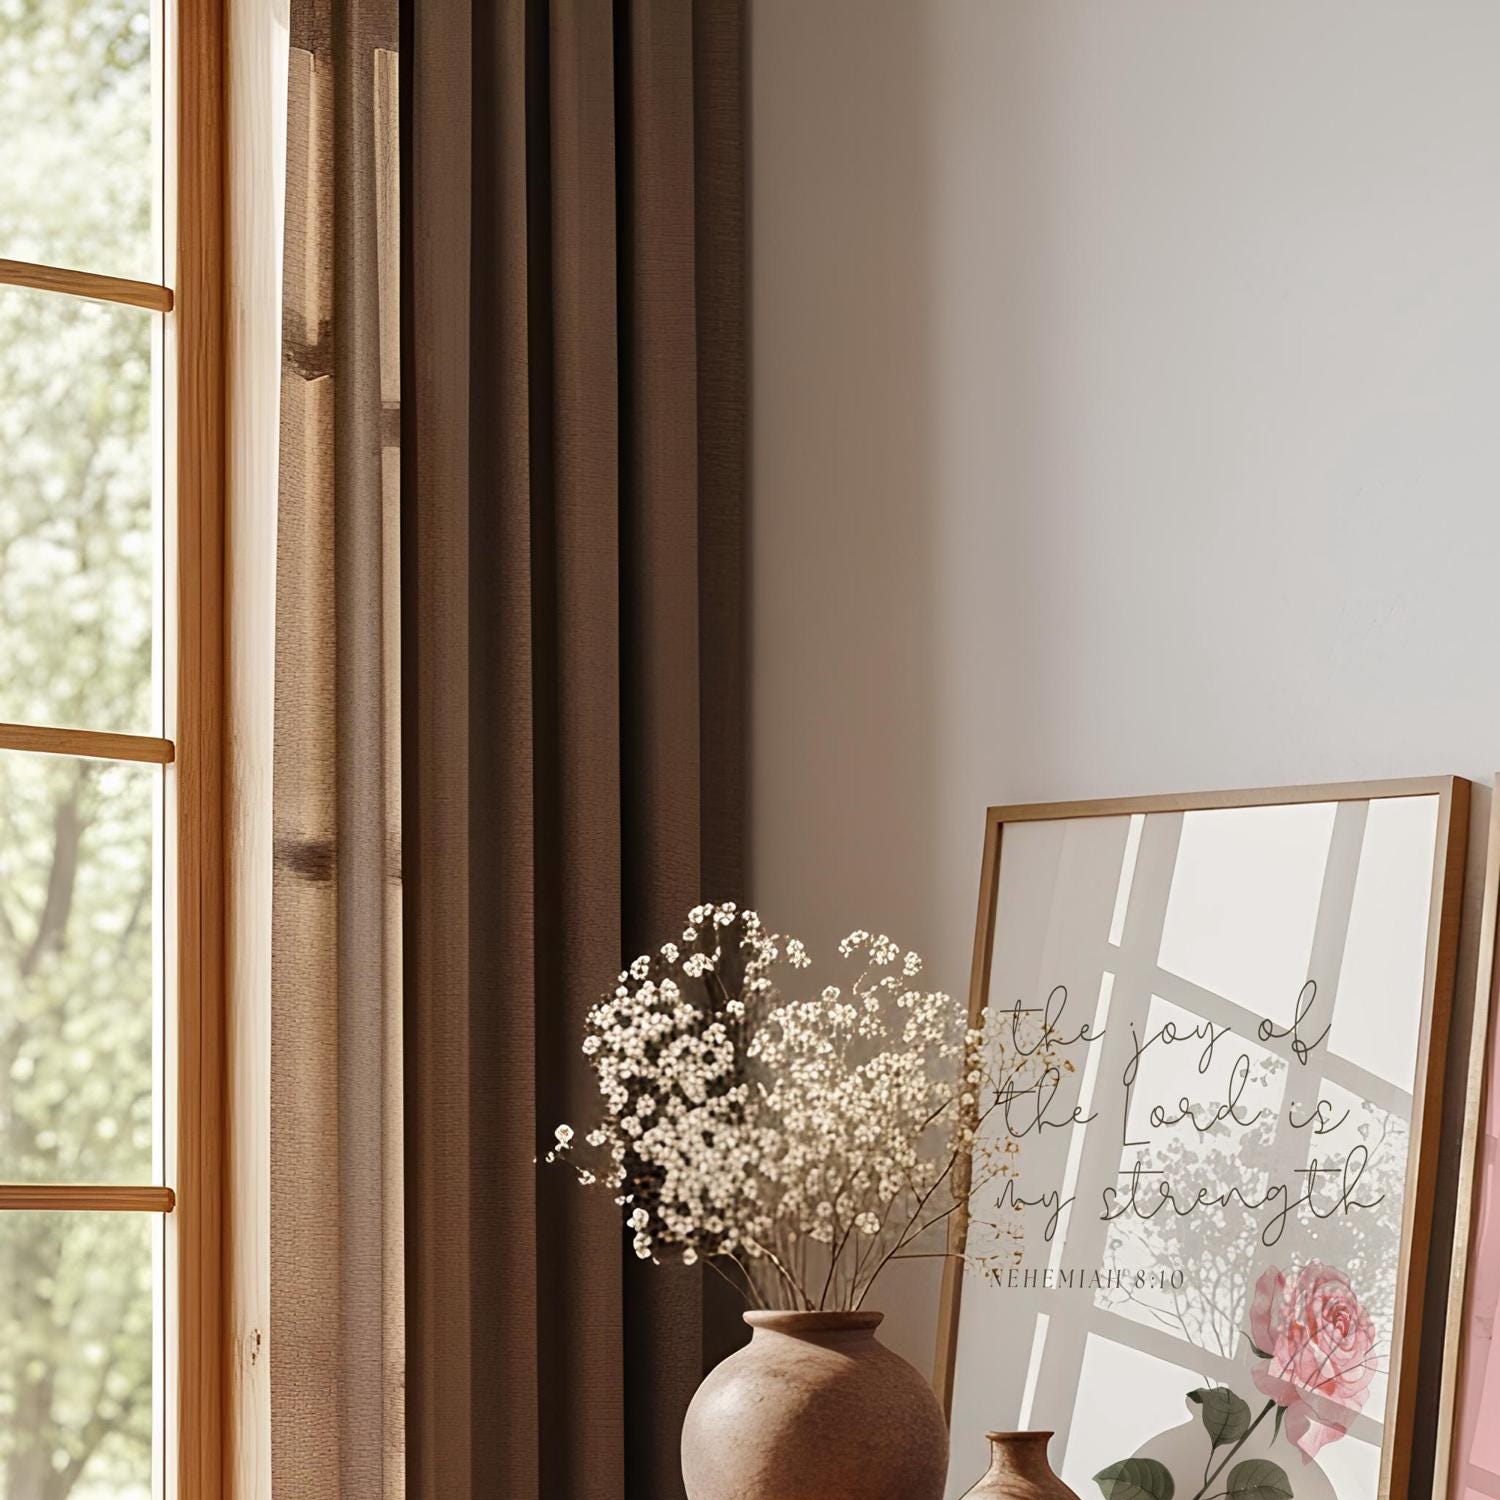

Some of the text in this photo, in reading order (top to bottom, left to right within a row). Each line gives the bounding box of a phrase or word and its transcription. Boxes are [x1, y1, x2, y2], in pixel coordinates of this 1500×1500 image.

[1000, 980, 1332, 1086] the joy of
[993, 1054, 1350, 1146] the Lord is
[994, 1145, 1386, 1247] my strength
[989, 1268, 1185, 1290] NEHEMIAH 8:10
